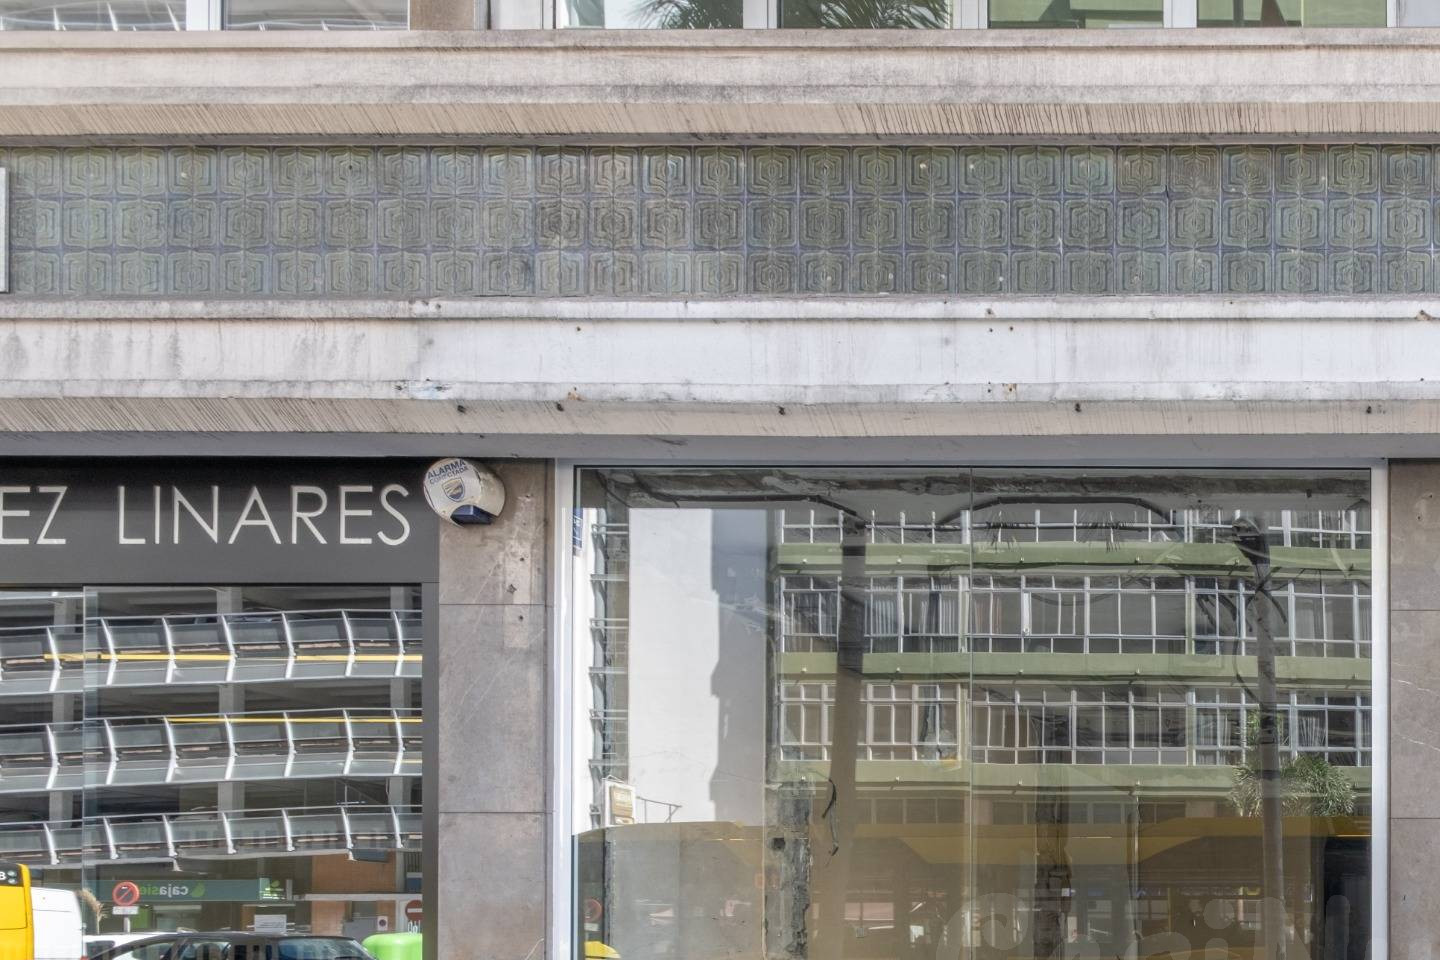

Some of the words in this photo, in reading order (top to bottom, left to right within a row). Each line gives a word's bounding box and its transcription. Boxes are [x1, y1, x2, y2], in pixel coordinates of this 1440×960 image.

[427, 460, 467, 479] ALARMA
[0, 485, 67, 544] EZ
[117, 484, 411, 546] LINARES
